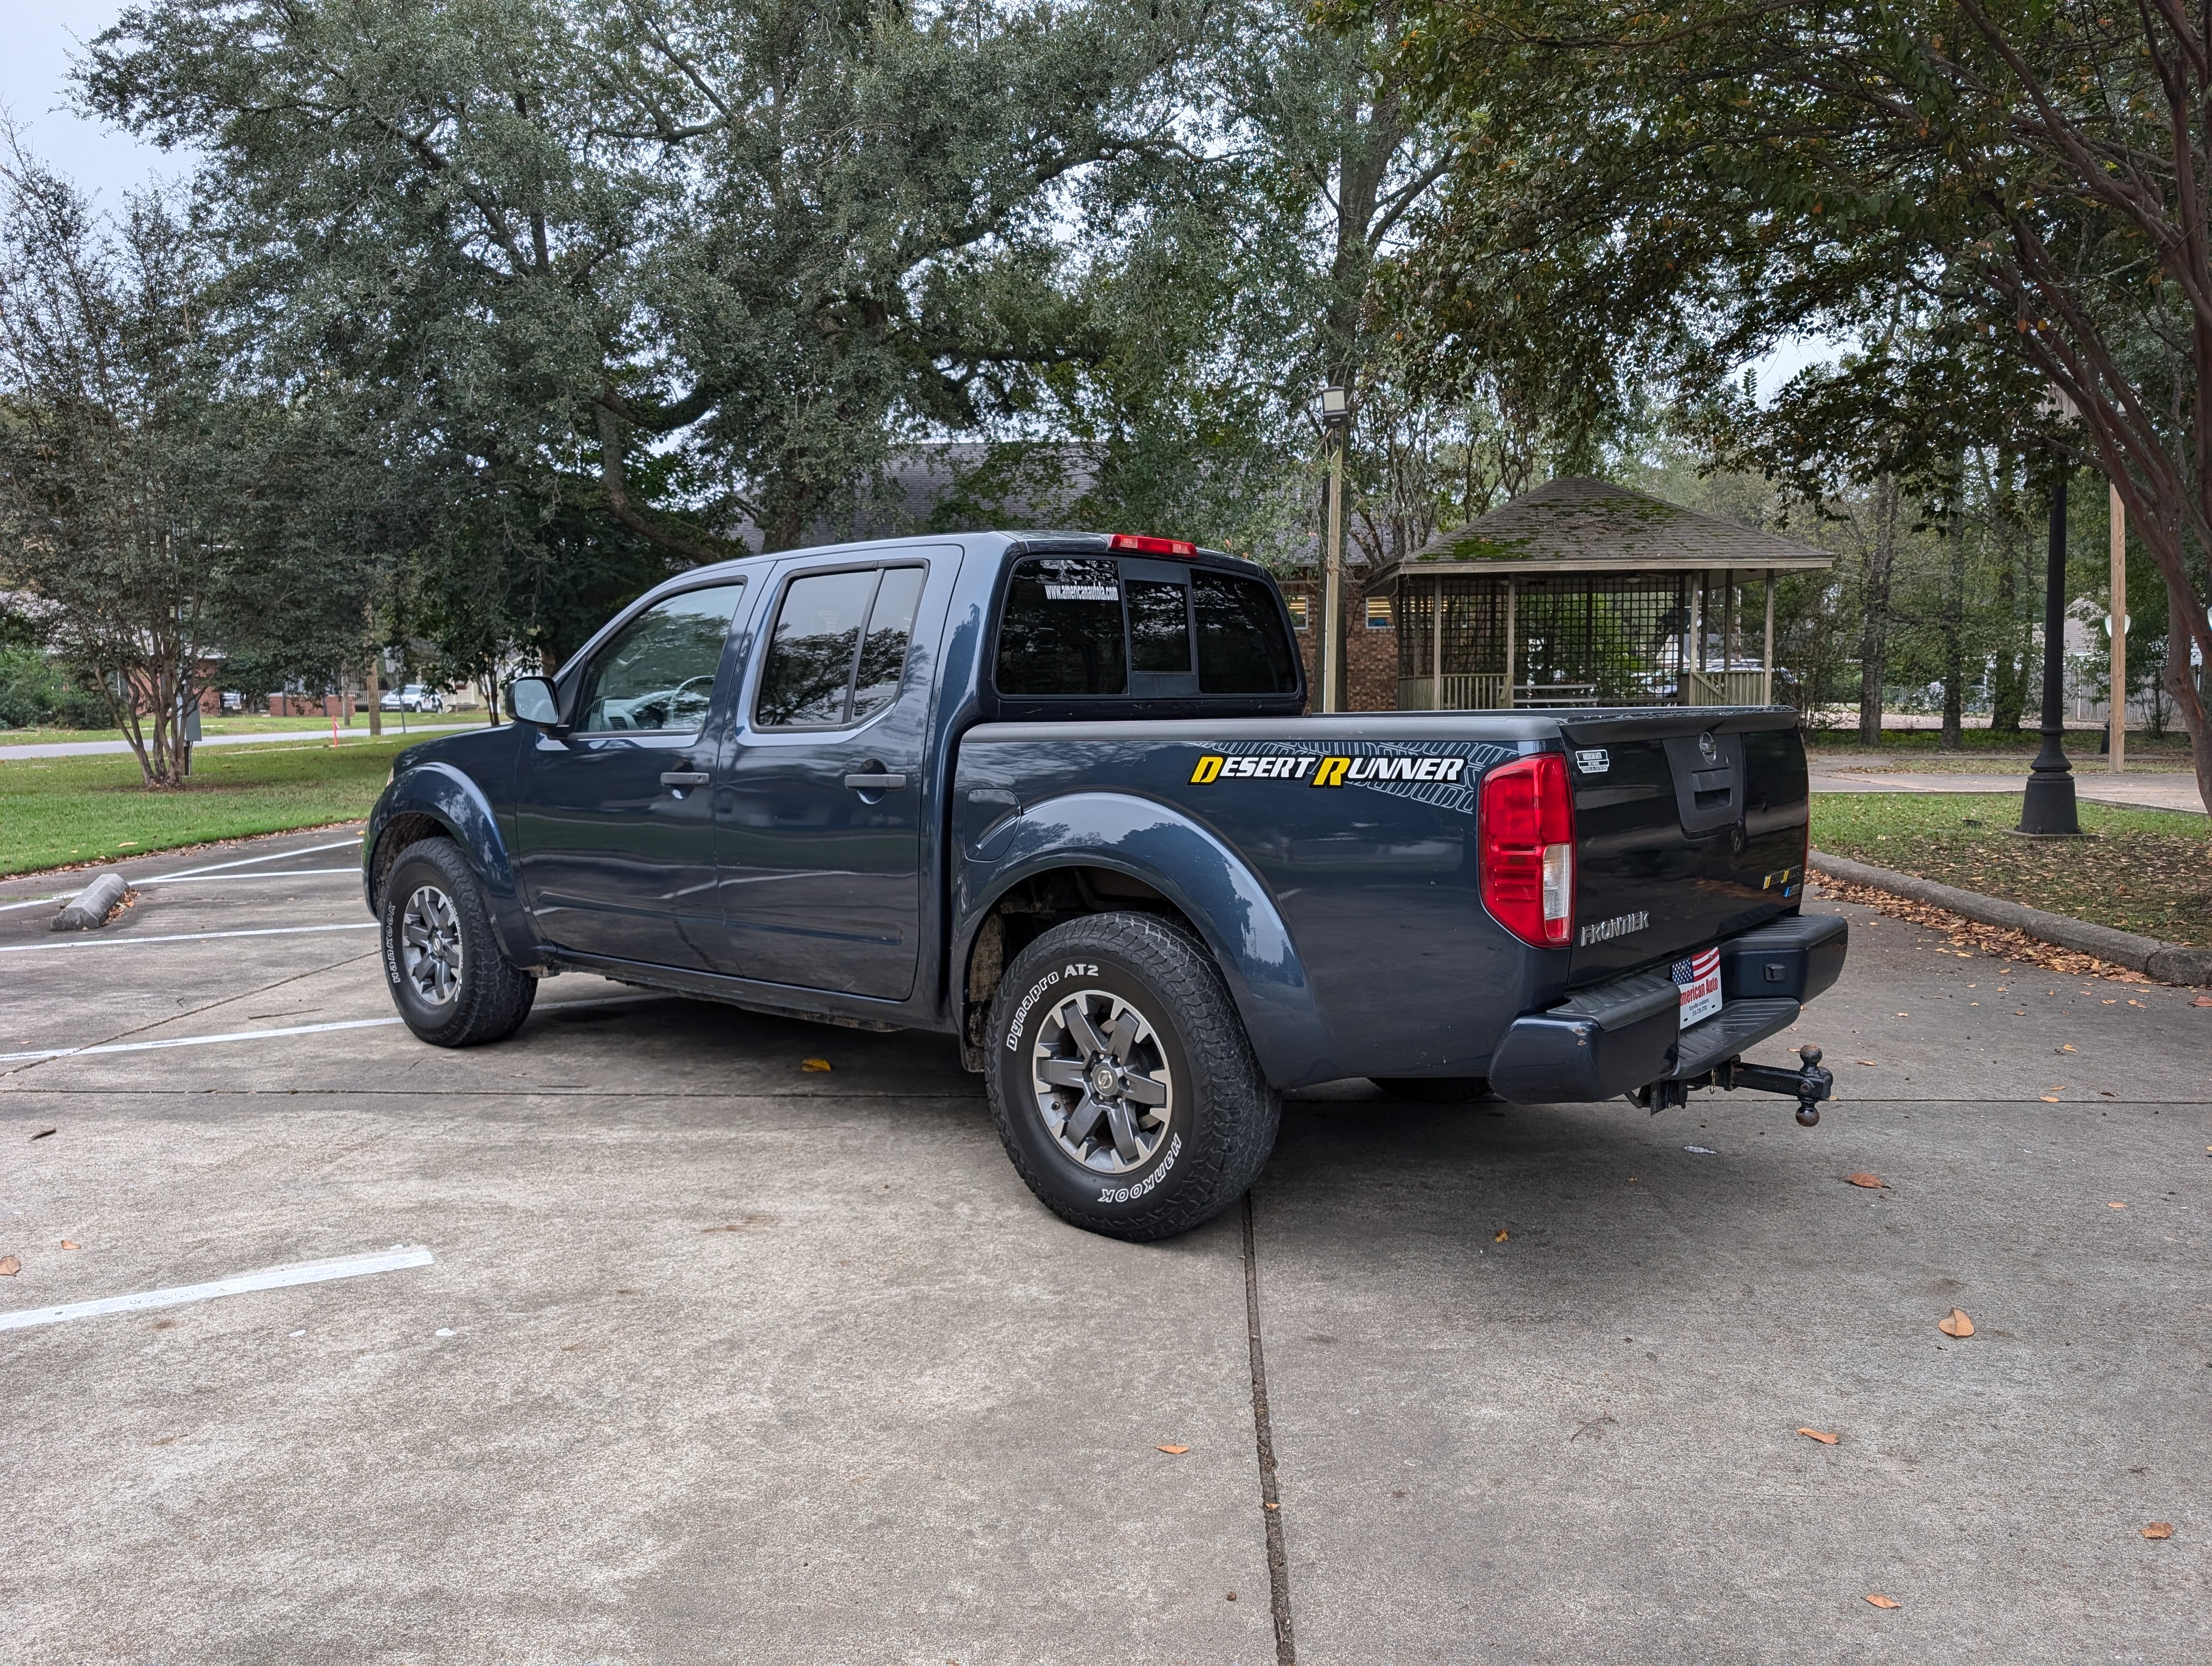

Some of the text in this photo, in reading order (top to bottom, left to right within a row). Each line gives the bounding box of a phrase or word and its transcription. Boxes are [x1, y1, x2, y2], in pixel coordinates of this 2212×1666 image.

[1044, 580, 1119, 601] www.americanautola.com
[1190, 756, 1464, 786] DESERT RUNNER
[1580, 911, 1649, 947] FRONTIER
[1706, 977, 1718, 994] Auto
[1006, 963, 1099, 1052] Dynapro AT2
